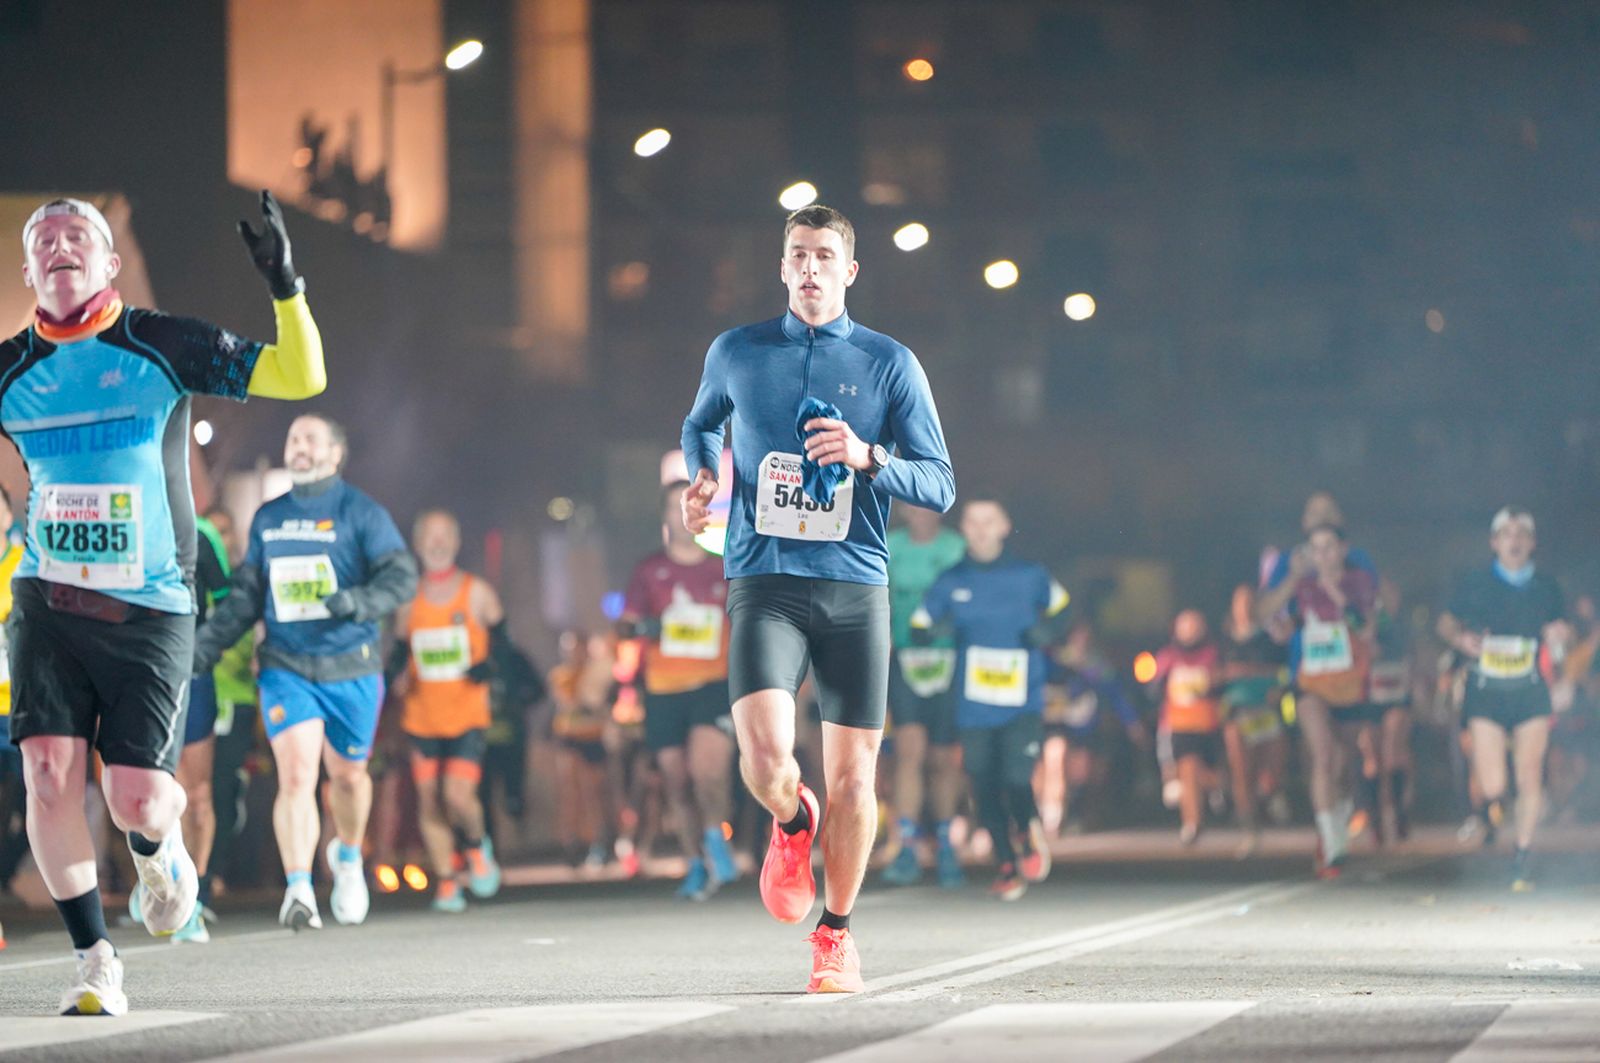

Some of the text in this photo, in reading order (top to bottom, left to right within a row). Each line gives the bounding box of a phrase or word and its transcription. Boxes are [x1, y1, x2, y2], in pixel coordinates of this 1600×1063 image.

[89, 415, 155, 452] LEGUA
[769, 471, 787, 482] SAN
[86, 497, 99, 508] DE
[43, 522, 128, 554] 12835
